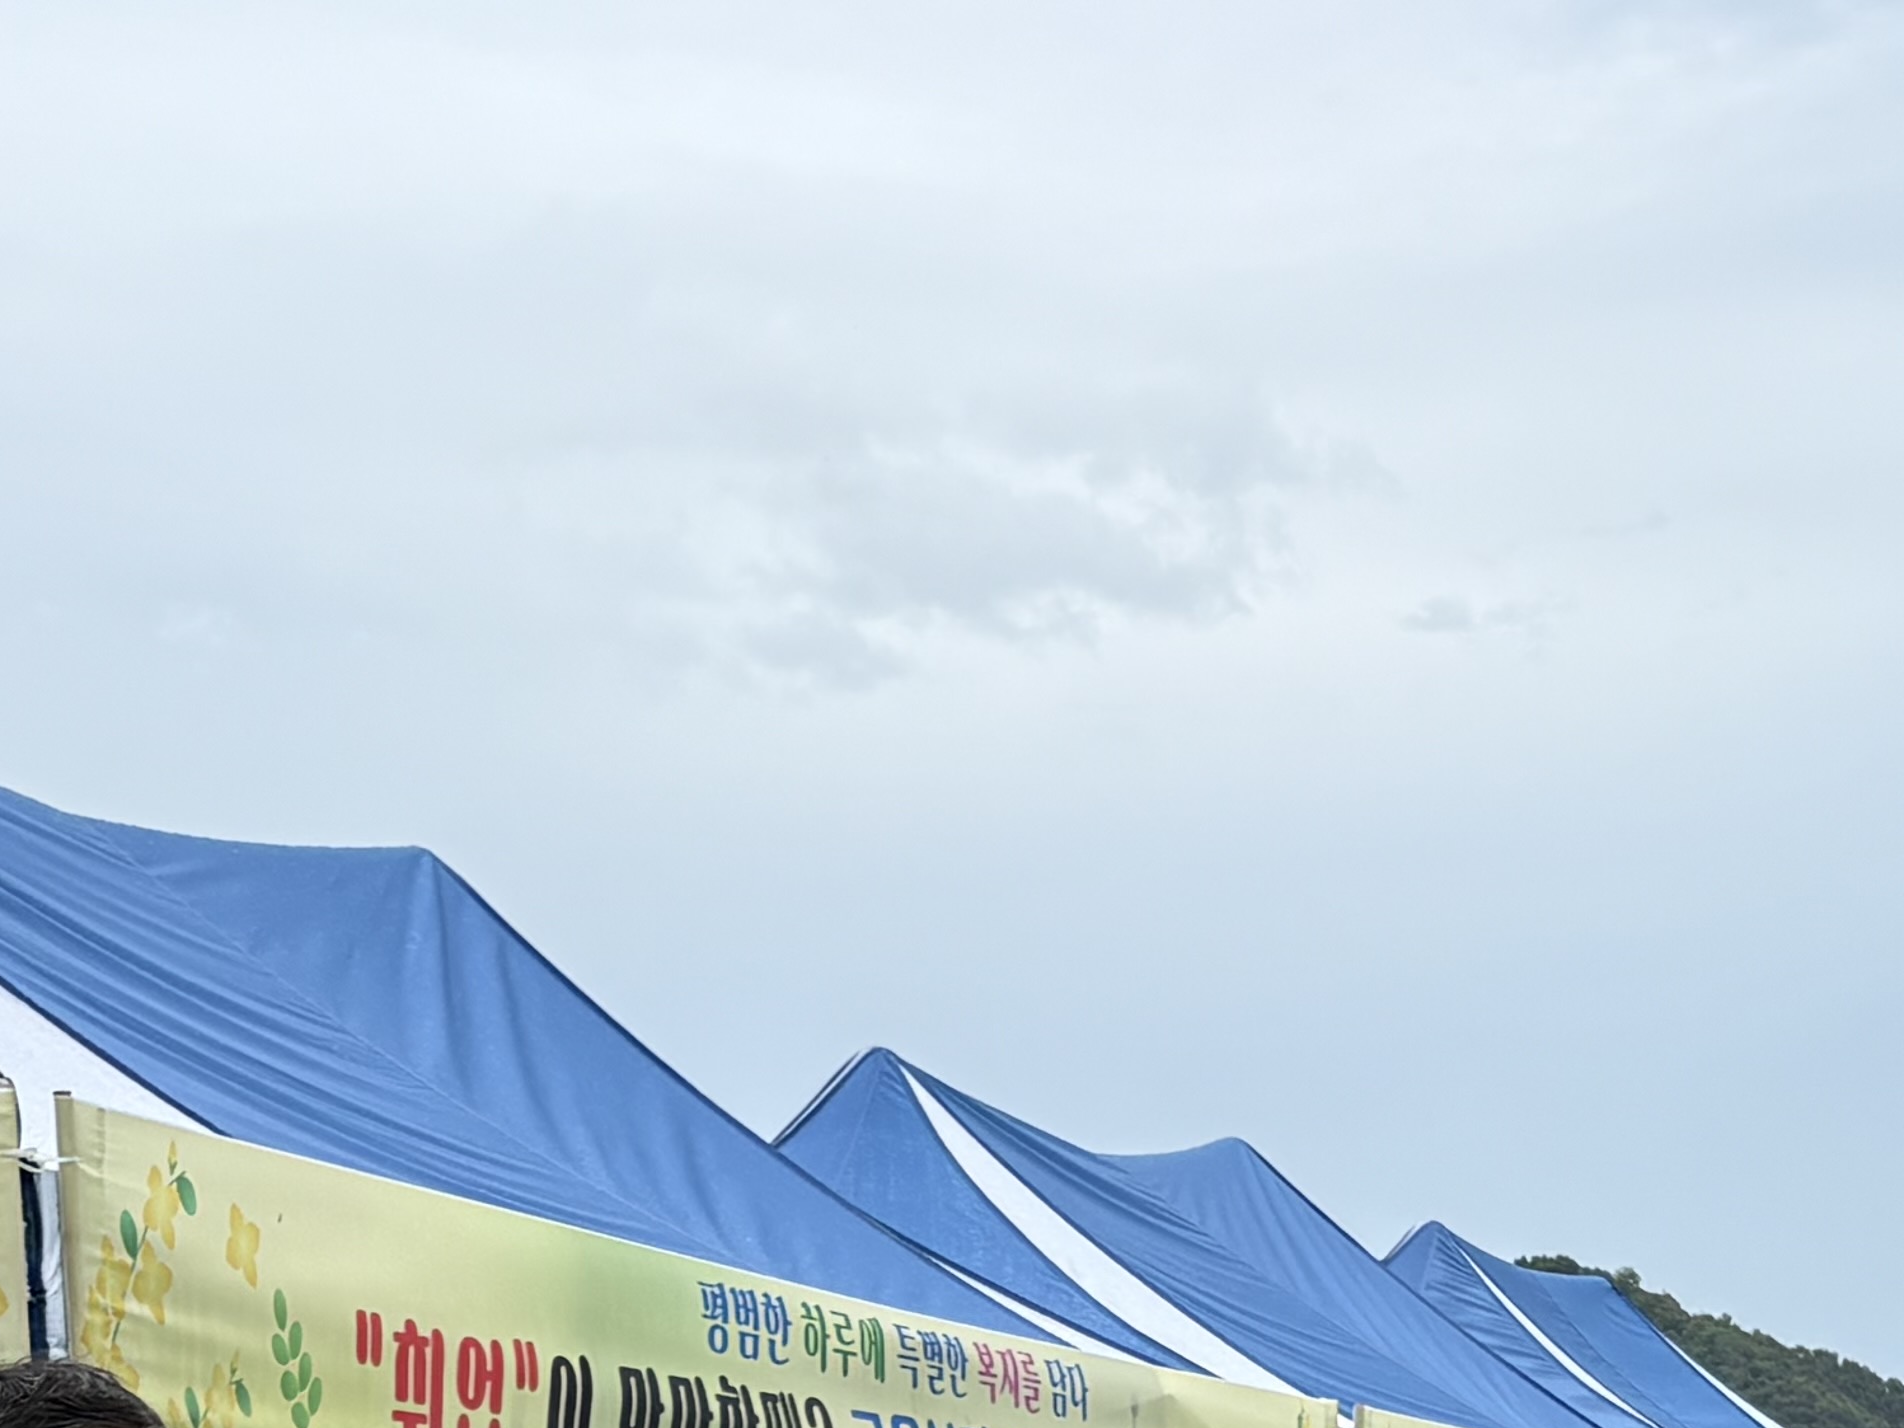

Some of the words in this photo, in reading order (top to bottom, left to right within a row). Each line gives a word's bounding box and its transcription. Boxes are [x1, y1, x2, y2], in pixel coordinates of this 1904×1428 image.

[697, 1280, 792, 1365] 평범한
[800, 1301, 885, 1383] 하루에
[891, 1323, 969, 1398] 특별한
[972, 1341, 1042, 1415] 복지를
[1043, 1358, 1089, 1422] 담다
